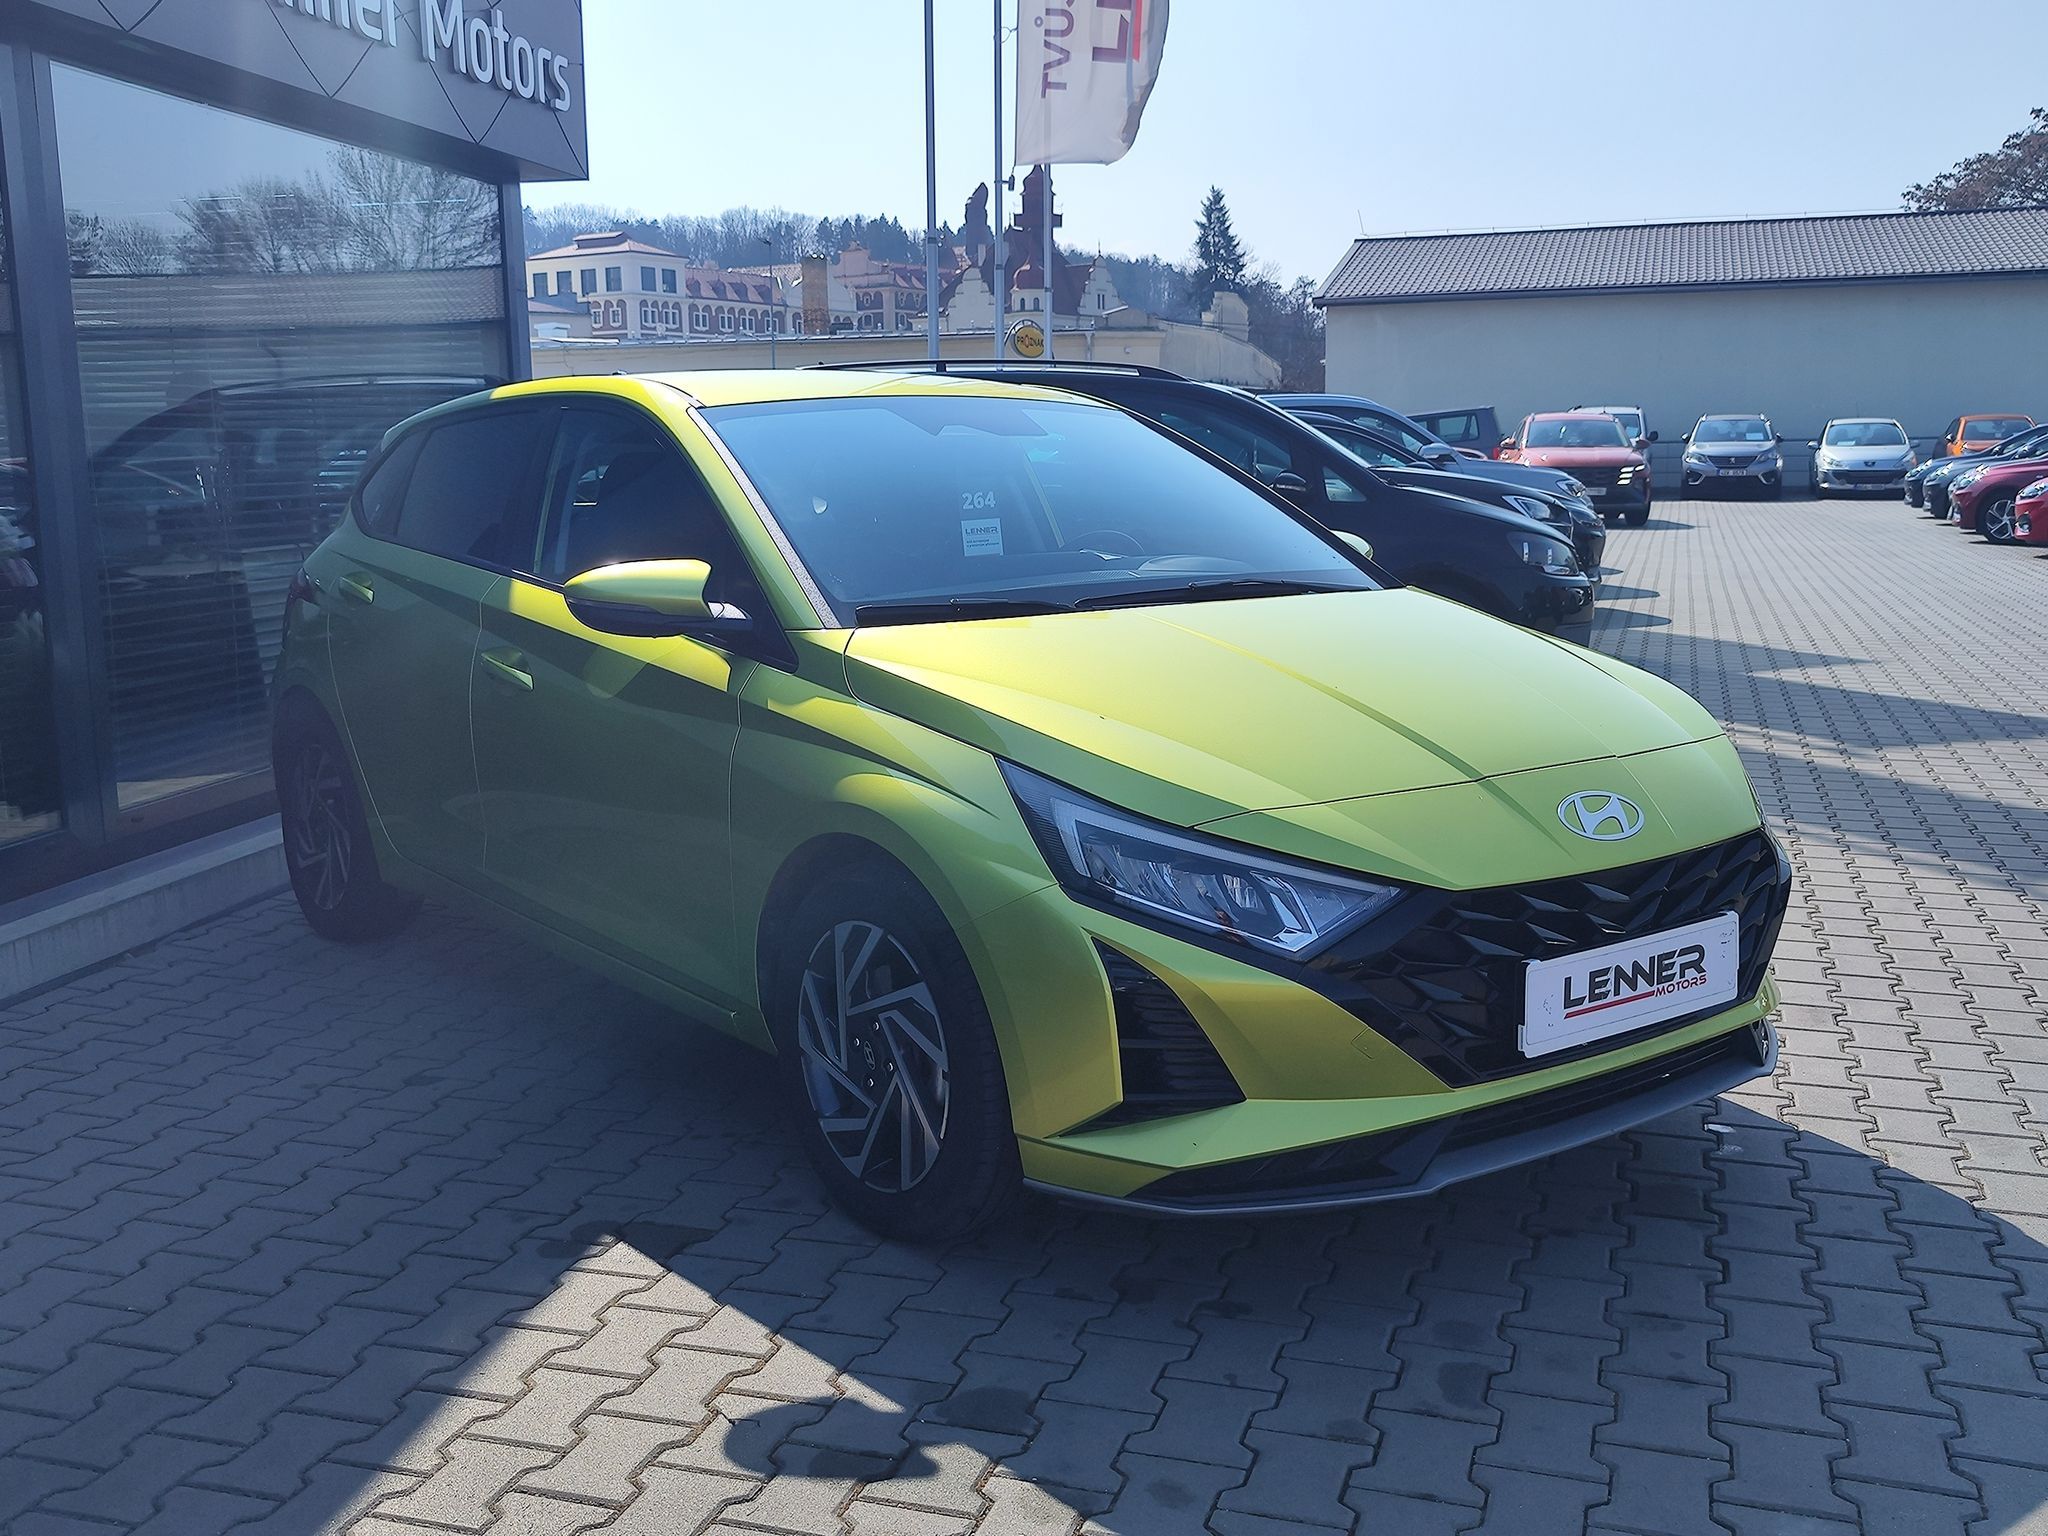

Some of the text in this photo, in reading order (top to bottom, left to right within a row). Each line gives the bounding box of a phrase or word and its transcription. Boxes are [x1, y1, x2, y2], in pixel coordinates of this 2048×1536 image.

[419, 0, 571, 112] Motors
[1034, 0, 1075, 99] TVŮ
[961, 491, 996, 510] 264
[965, 527, 999, 535] LENNER
[1563, 944, 1708, 1010] LENNER
[1654, 974, 1708, 998] MOTORS
